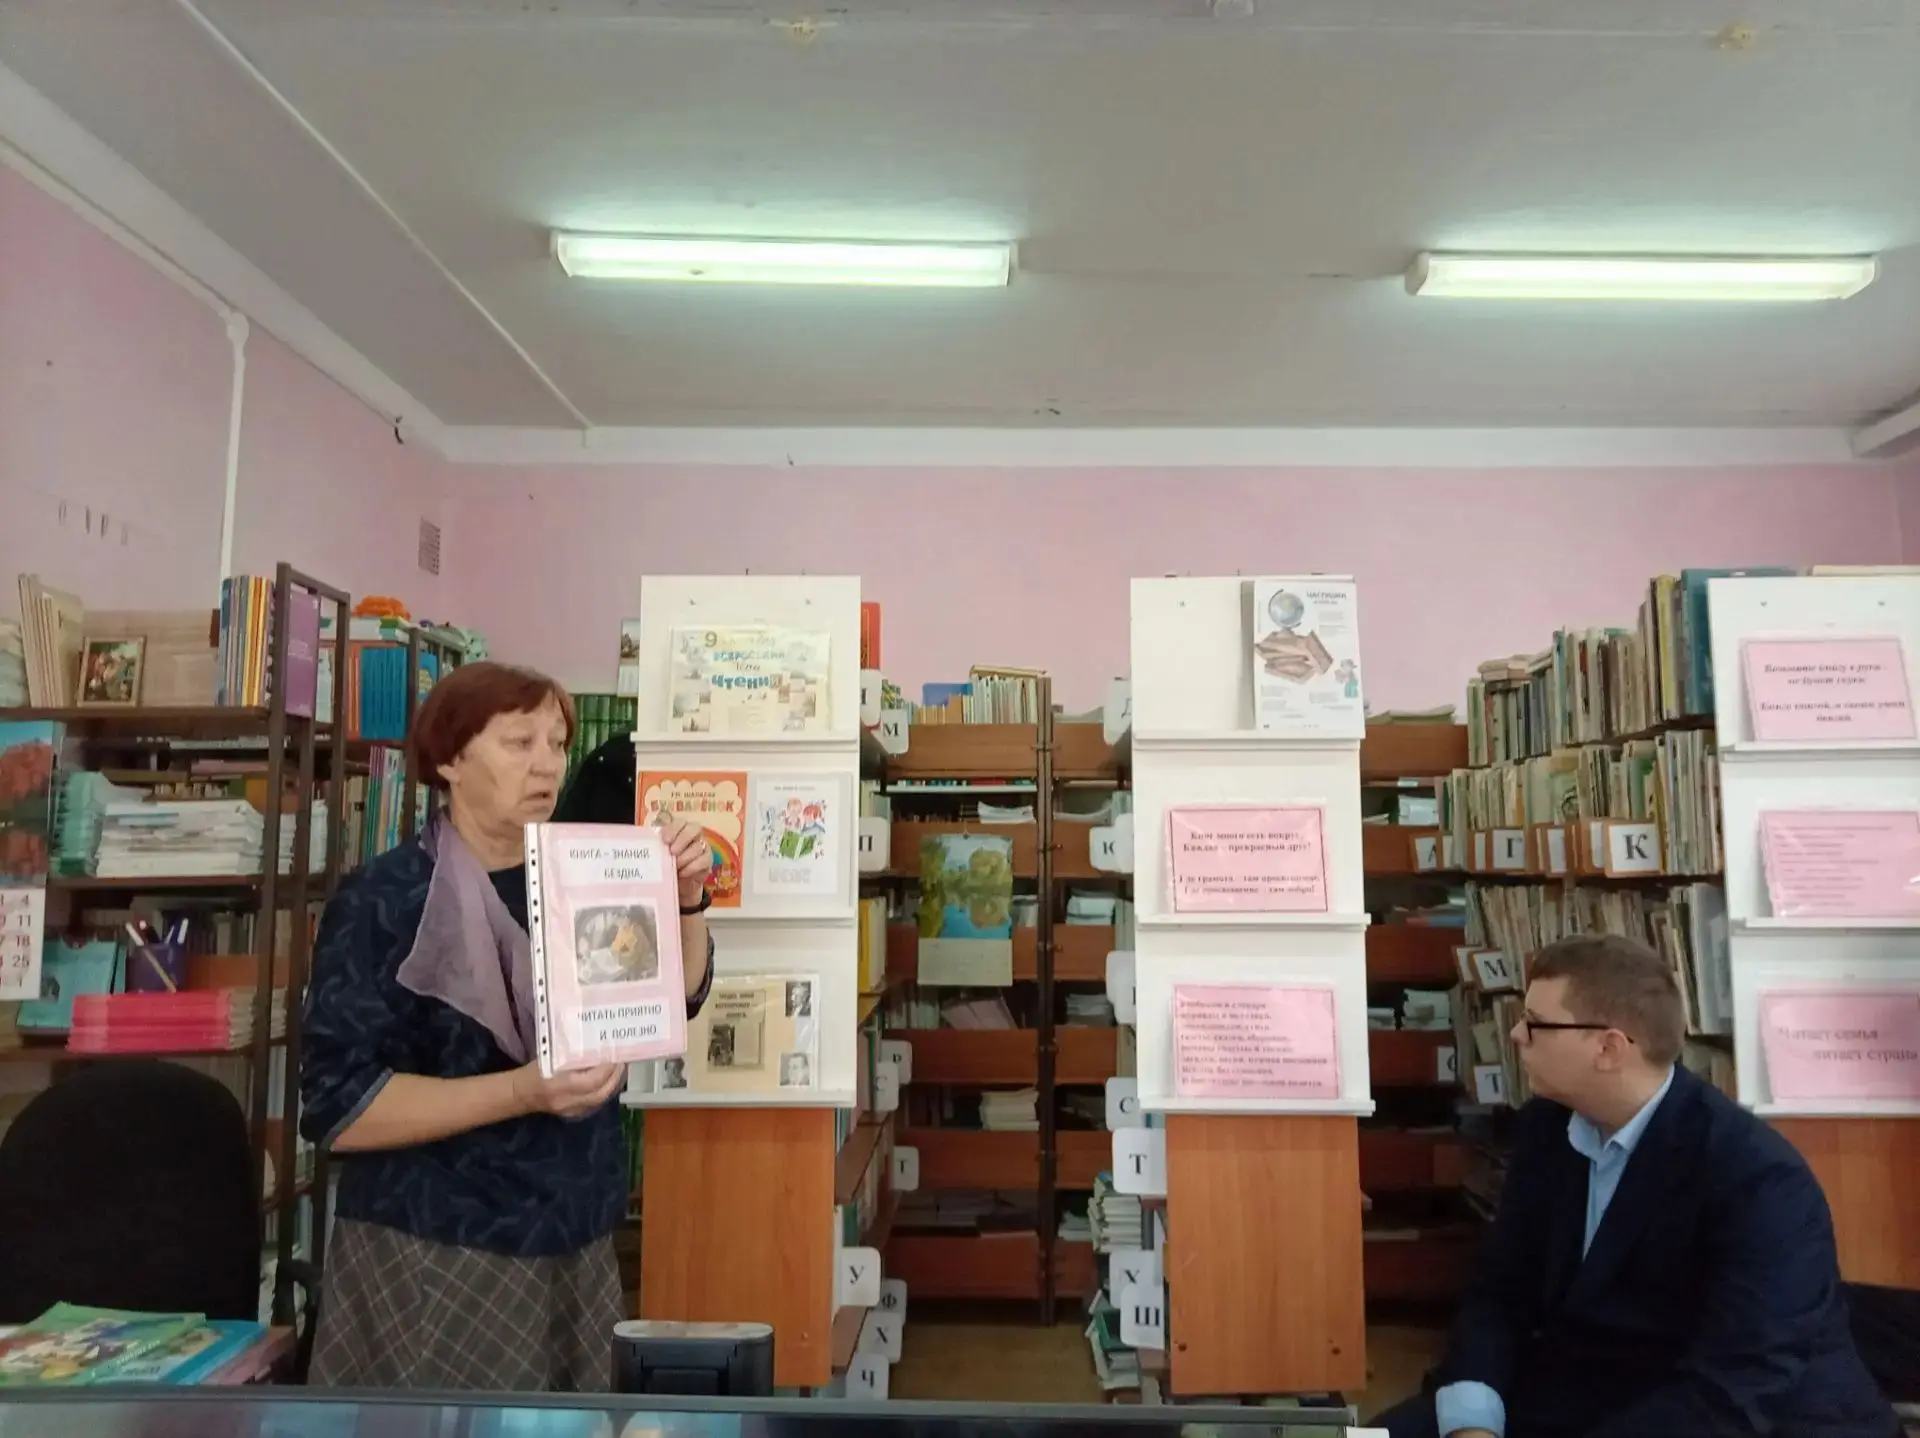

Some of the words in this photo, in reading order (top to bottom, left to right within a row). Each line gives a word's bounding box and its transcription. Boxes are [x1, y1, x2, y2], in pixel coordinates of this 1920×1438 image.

[704, 631, 718, 648] 9
[883, 723, 899, 737] М
[569, 847, 602, 860] КНИГА
[611, 847, 650, 860] ЗНАНИЙ
[1506, 837, 1523, 859] Г
[1622, 833, 1649, 860] К
[1483, 958, 1508, 980] М
[577, 1008, 615, 1022] ЧИТАТЬ
[617, 1004, 662, 1018] ПРИЯТНО
[600, 1029, 607, 1041] И
[612, 1023, 657, 1039] ПОЛЕЗНО
[1485, 1072, 1500, 1095] Т
[1119, 1096, 1134, 1114] С
[897, 1158, 908, 1174] Т
[1129, 1153, 1147, 1176] Т
[849, 1265, 864, 1285] У
[1123, 1269, 1140, 1285] Х
[881, 1292, 897, 1309] Ф
[1134, 1304, 1161, 1328] Ш
[875, 1325, 889, 1346] Х
[861, 1369, 875, 1389] Ч
